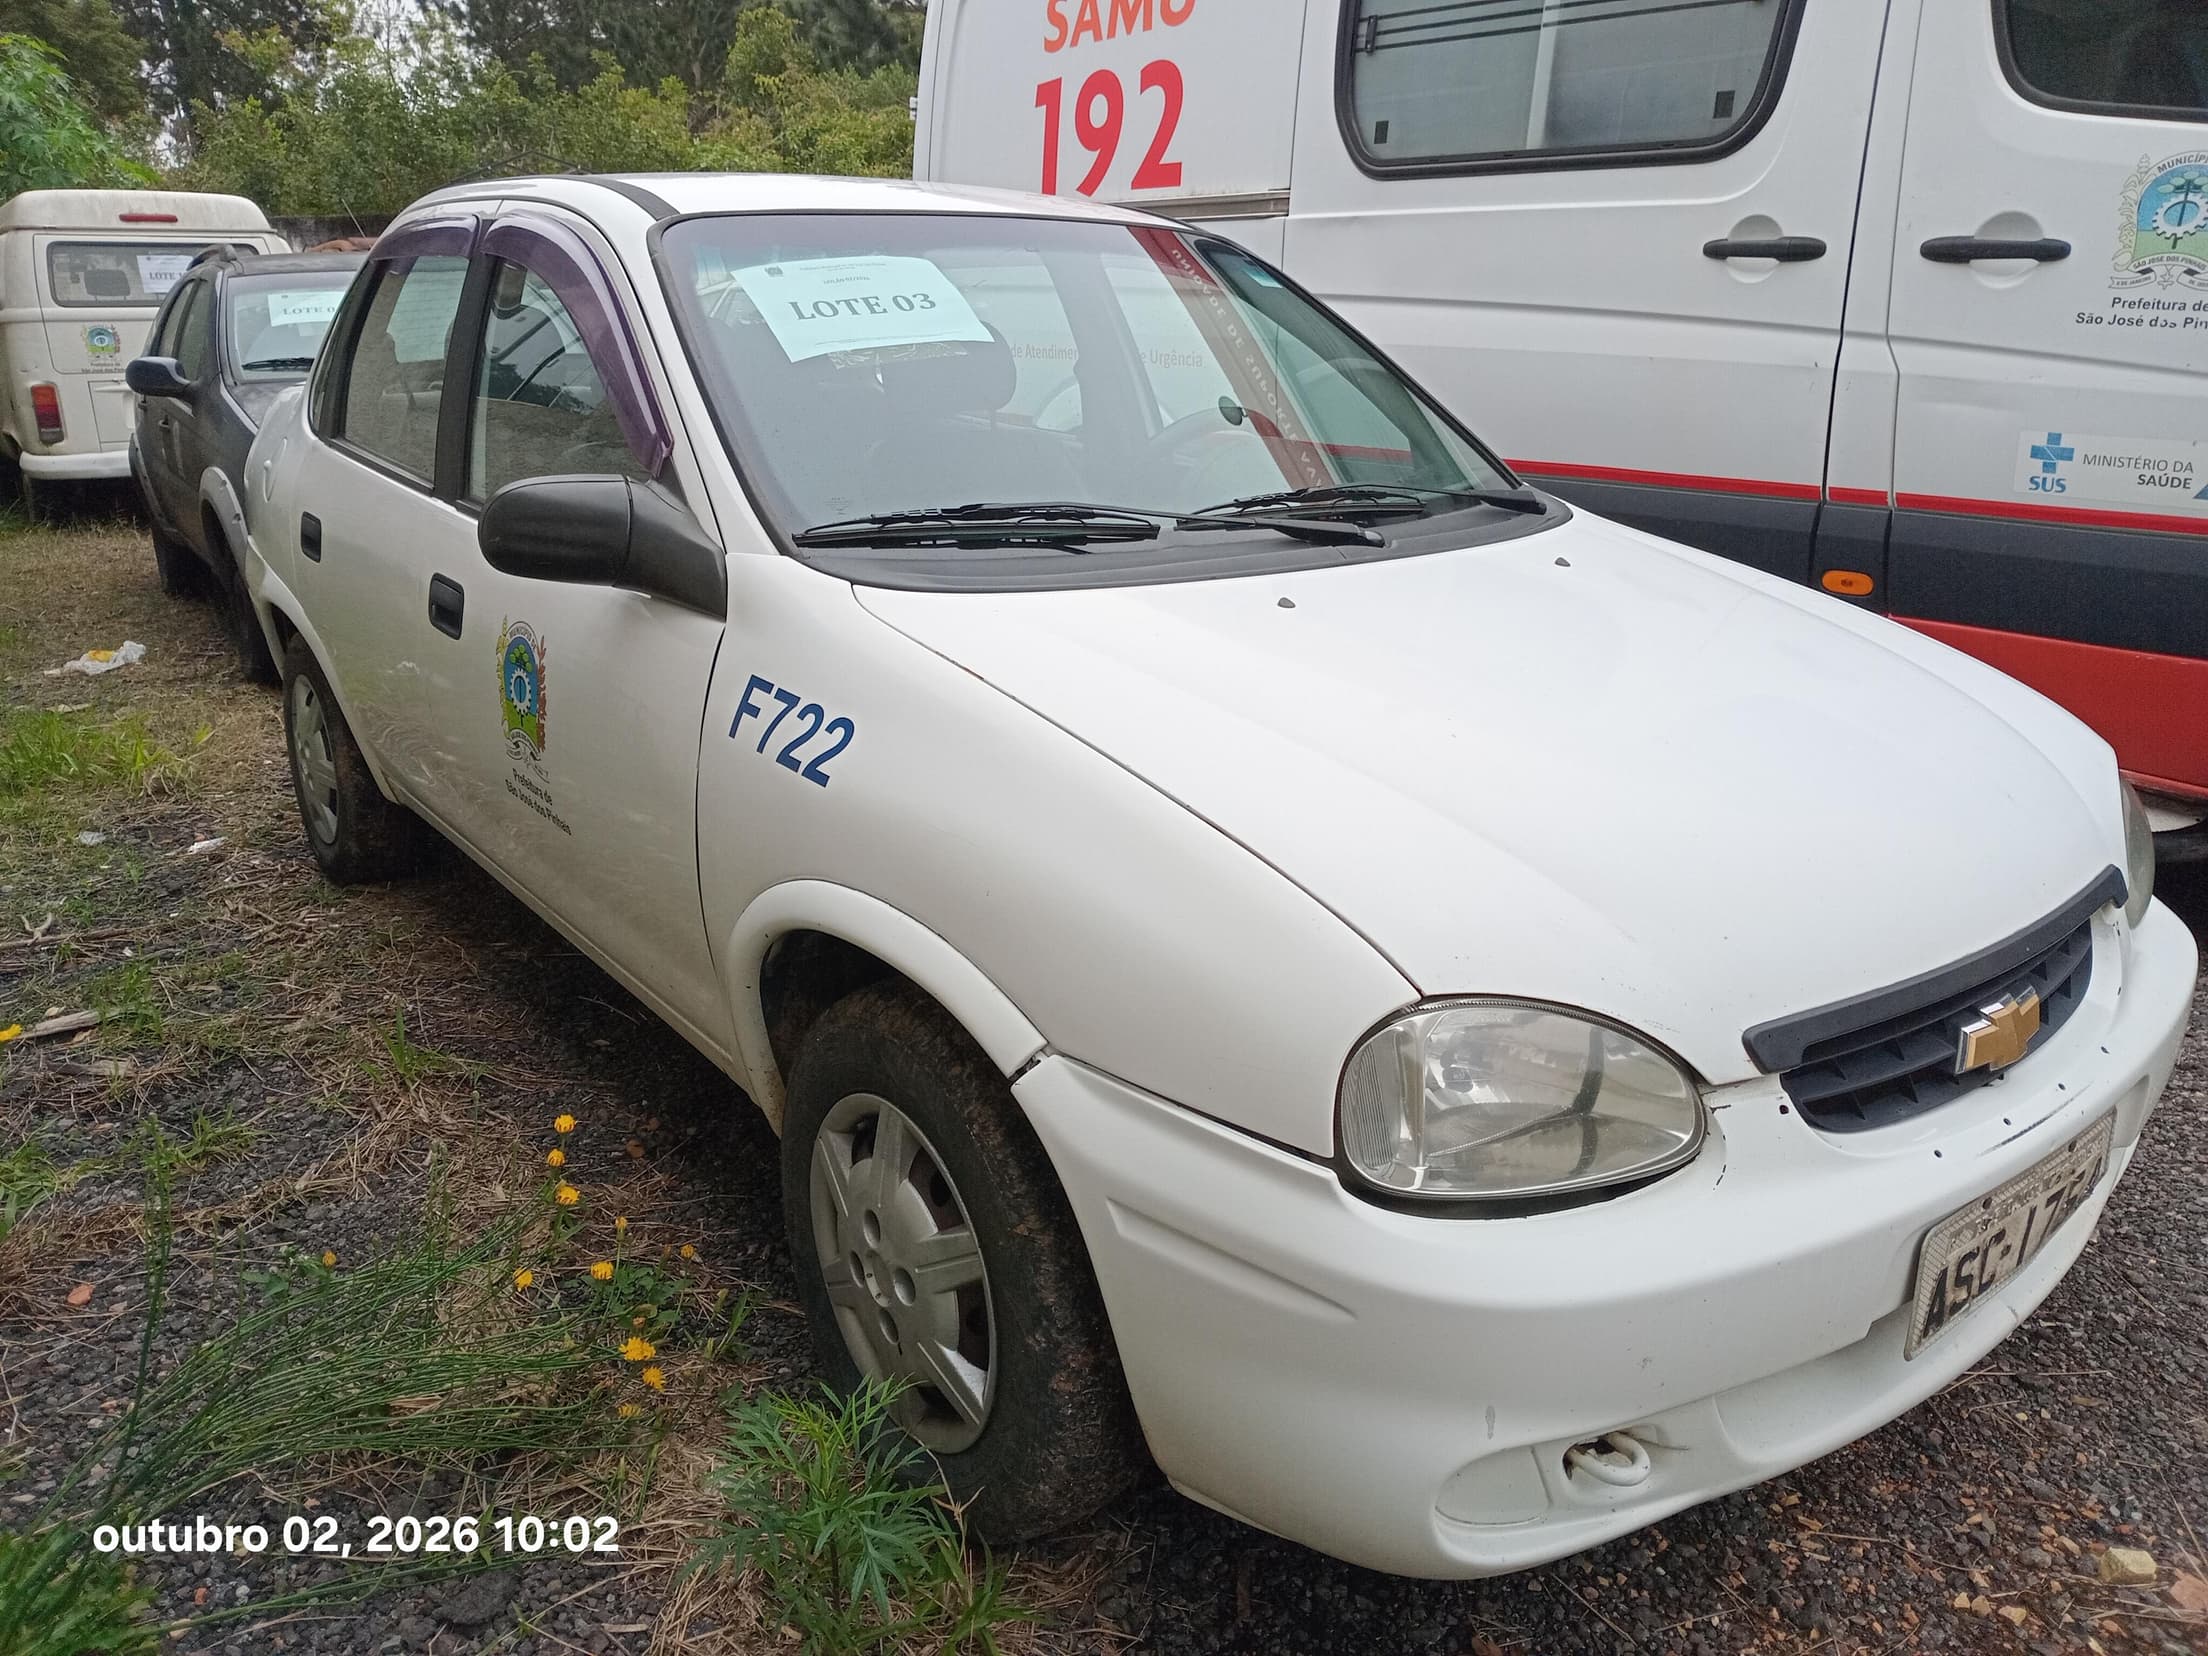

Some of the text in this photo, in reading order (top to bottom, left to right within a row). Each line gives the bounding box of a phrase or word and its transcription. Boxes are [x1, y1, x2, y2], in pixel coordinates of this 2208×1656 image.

[1035, 59, 1183, 197] 192
[283, 306, 322, 315] LOTE
[788, 292, 937, 321] LOTE 03
[2111, 297, 2208, 312] Prefeitura de
[2075, 312, 2103, 325] São
[2107, 314, 2144, 327] José
[2149, 316, 2177, 328] dos
[1151, 348, 1202, 368] Urgência
[2082, 453, 2194, 473] MINISTÉRIO DA
[2028, 475, 2066, 493] SUS
[2137, 473, 2193, 489] SAÚDE
[729, 674, 855, 788] F722
